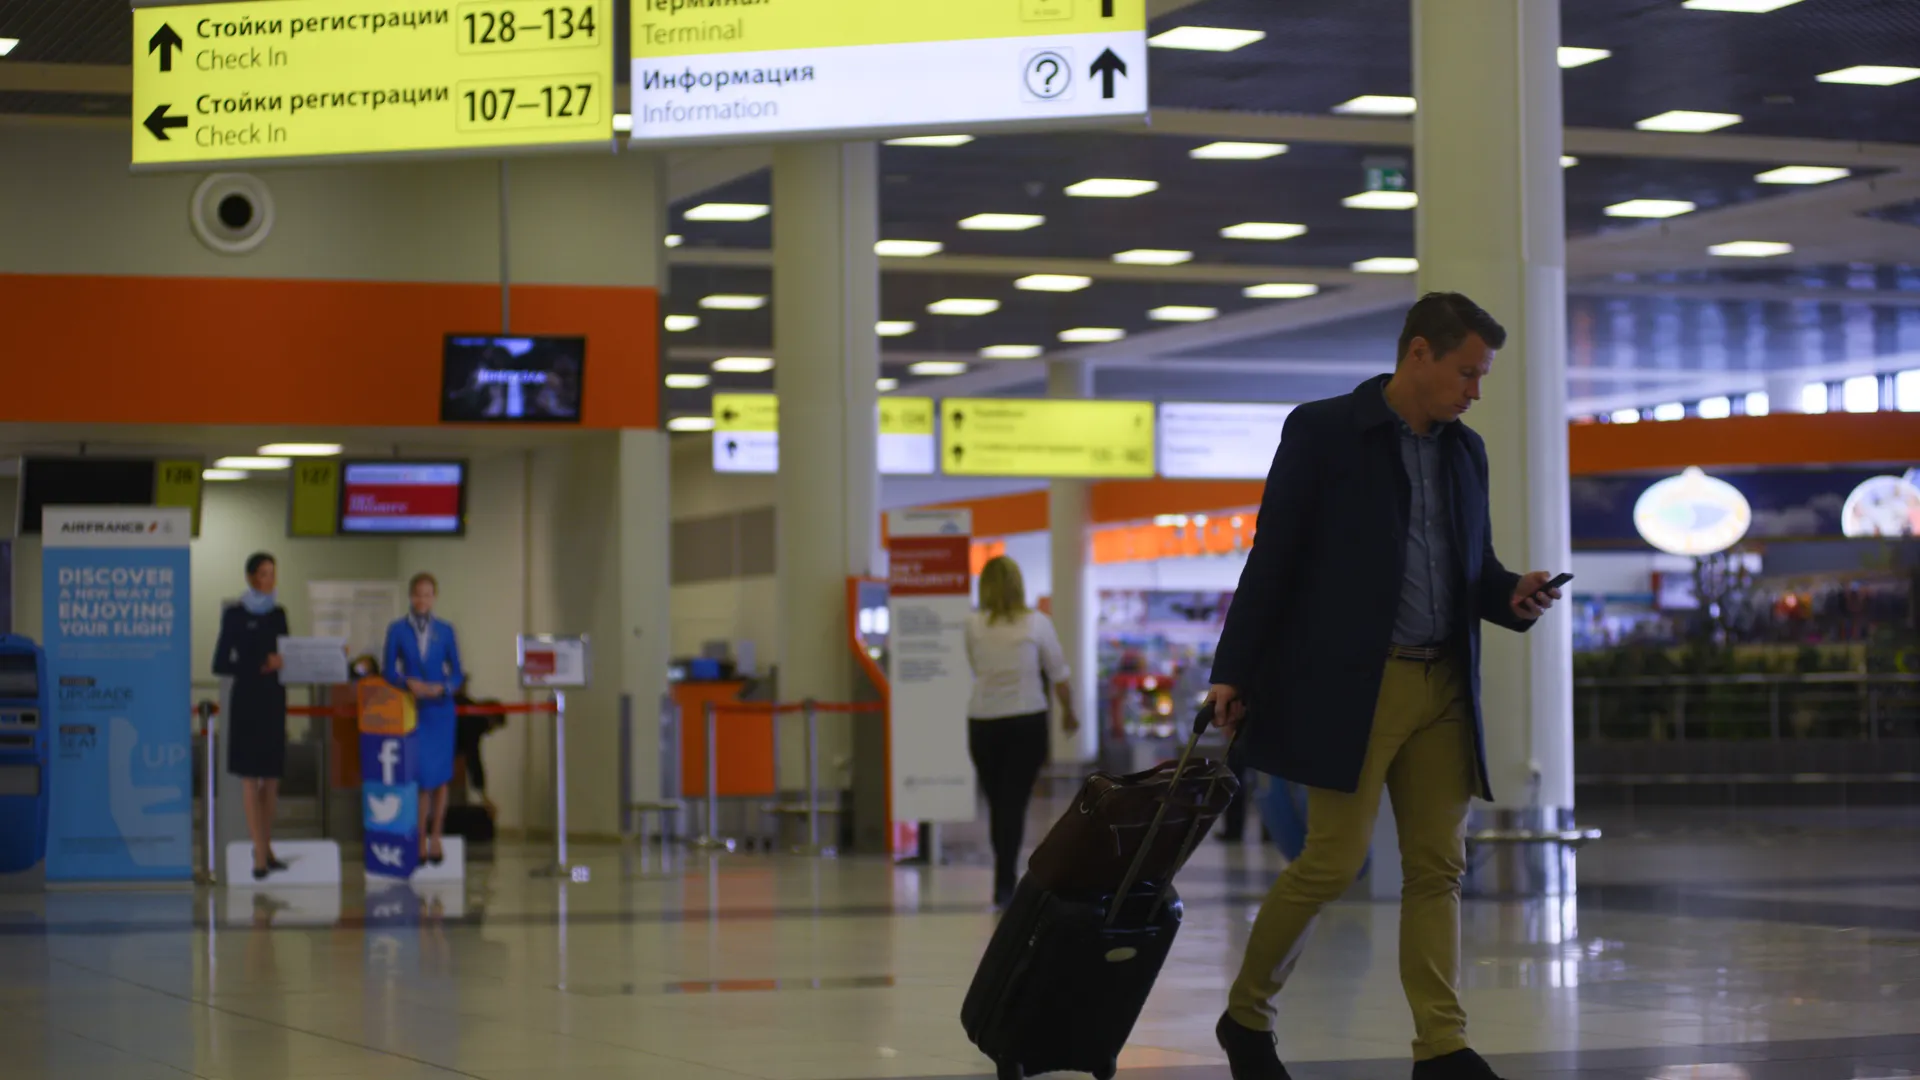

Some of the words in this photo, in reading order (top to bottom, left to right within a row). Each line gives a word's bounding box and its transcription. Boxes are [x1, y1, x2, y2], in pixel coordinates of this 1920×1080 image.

[645, 0, 770, 16] Терми
[196, 16, 283, 38] Стойки
[290, 8, 449, 38] регистрации
[642, 18, 743, 45] Terminal
[195, 47, 262, 71] Check
[268, 46, 288, 67] In
[643, 65, 815, 93] Информация
[196, 92, 282, 114] Стойки
[290, 87, 449, 115] регистрации
[643, 98, 778, 124] Information
[195, 123, 261, 147] Check
[267, 122, 287, 143] In
[58, 566, 174, 586] DISCOVER
[58, 600, 174, 620] ENJOYING
[59, 620, 109, 637] YOUR
[113, 620, 174, 637] FLIGHT
[142, 742, 186, 768] UP
